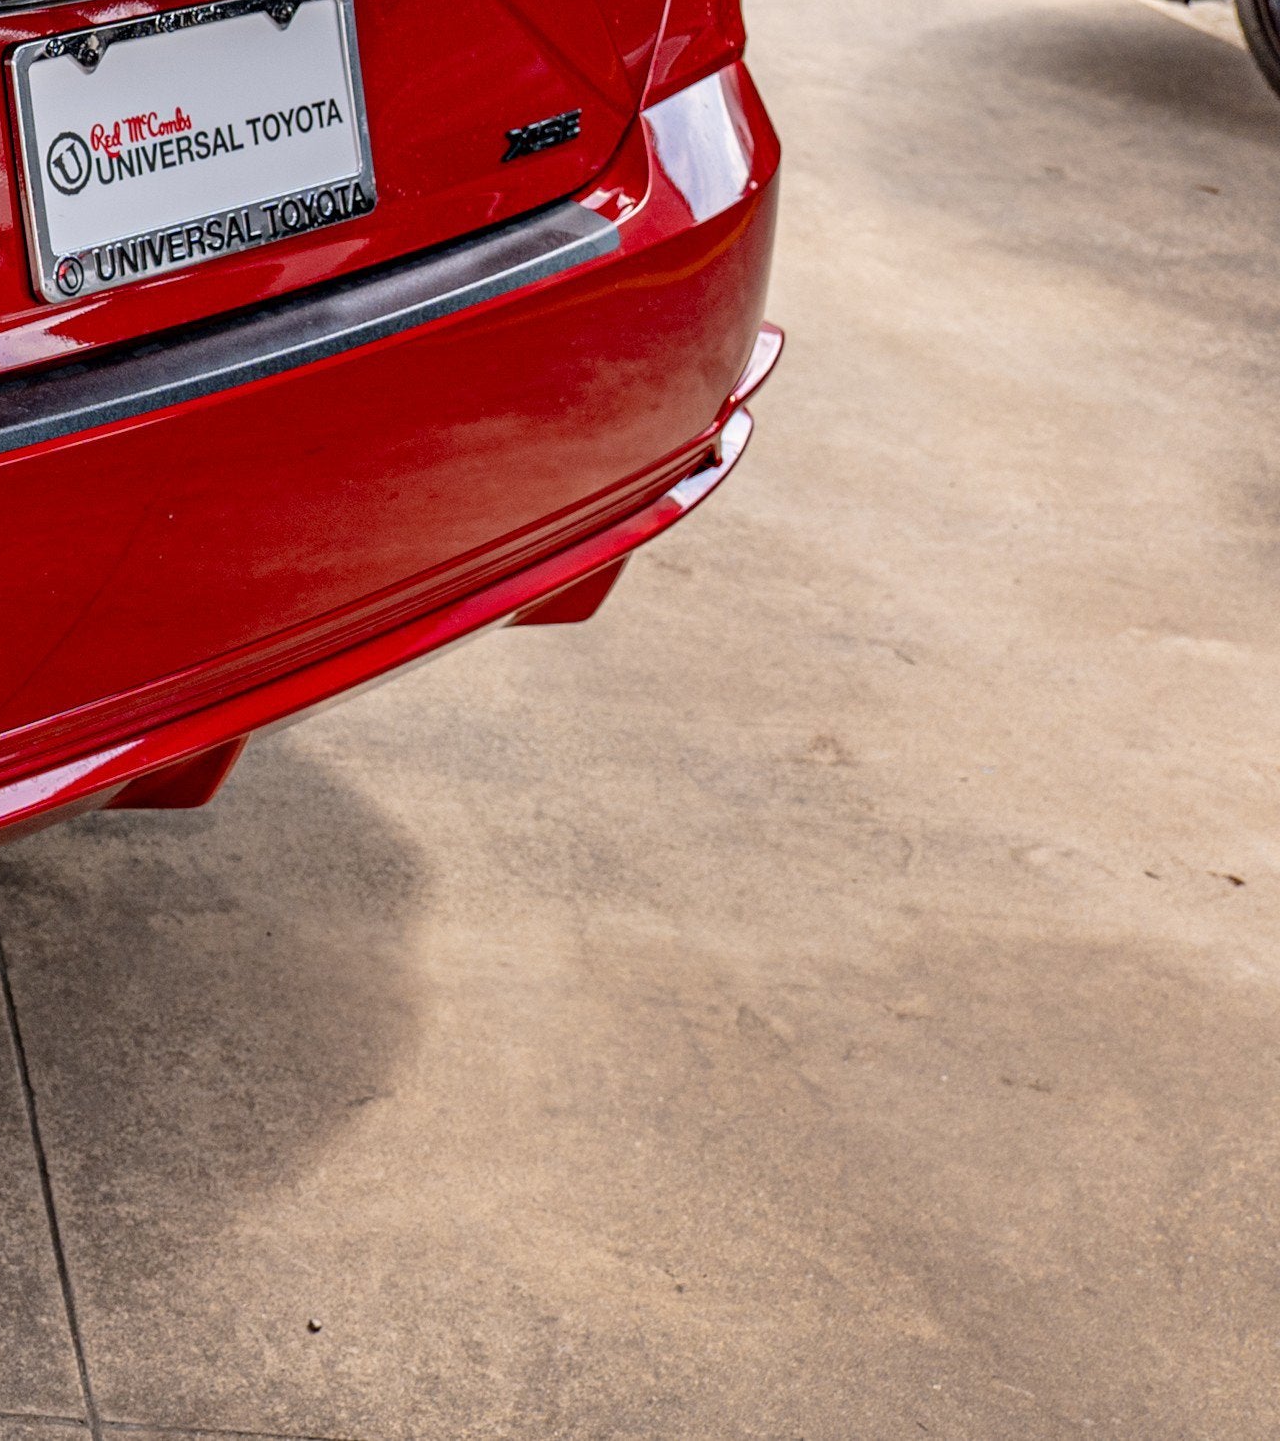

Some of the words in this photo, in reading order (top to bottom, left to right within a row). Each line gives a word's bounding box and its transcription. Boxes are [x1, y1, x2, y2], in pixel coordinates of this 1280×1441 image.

[91, 122, 122, 159] Red
[121, 107, 192, 144] McCombs
[95, 123, 244, 185] UNIVERSAL
[246, 98, 343, 146] TOYOTA
[501, 108, 582, 163] XSE
[94, 210, 262, 282] UNIVERSAL
[260, 181, 367, 235] TOYOTA
